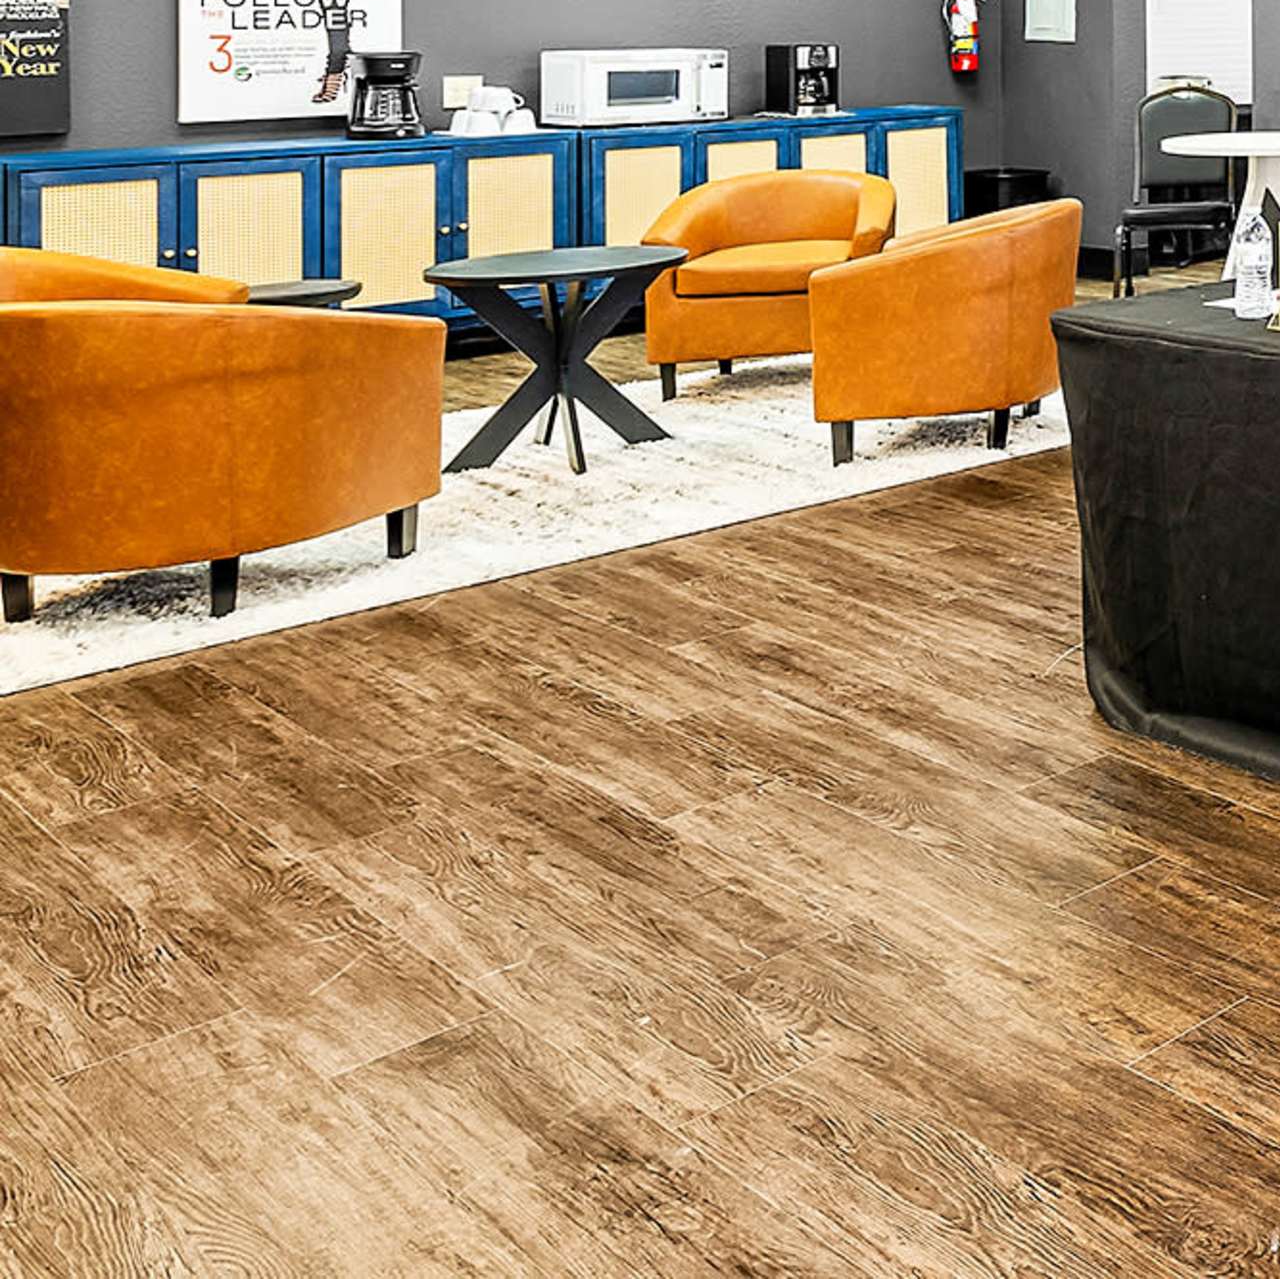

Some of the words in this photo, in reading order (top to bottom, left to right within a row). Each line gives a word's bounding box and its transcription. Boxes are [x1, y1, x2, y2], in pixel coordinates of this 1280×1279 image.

[232, 9, 368, 30] LEADER
[1, 38, 60, 58] New
[209, 35, 233, 74] 3
[0, 58, 61, 77] Year
